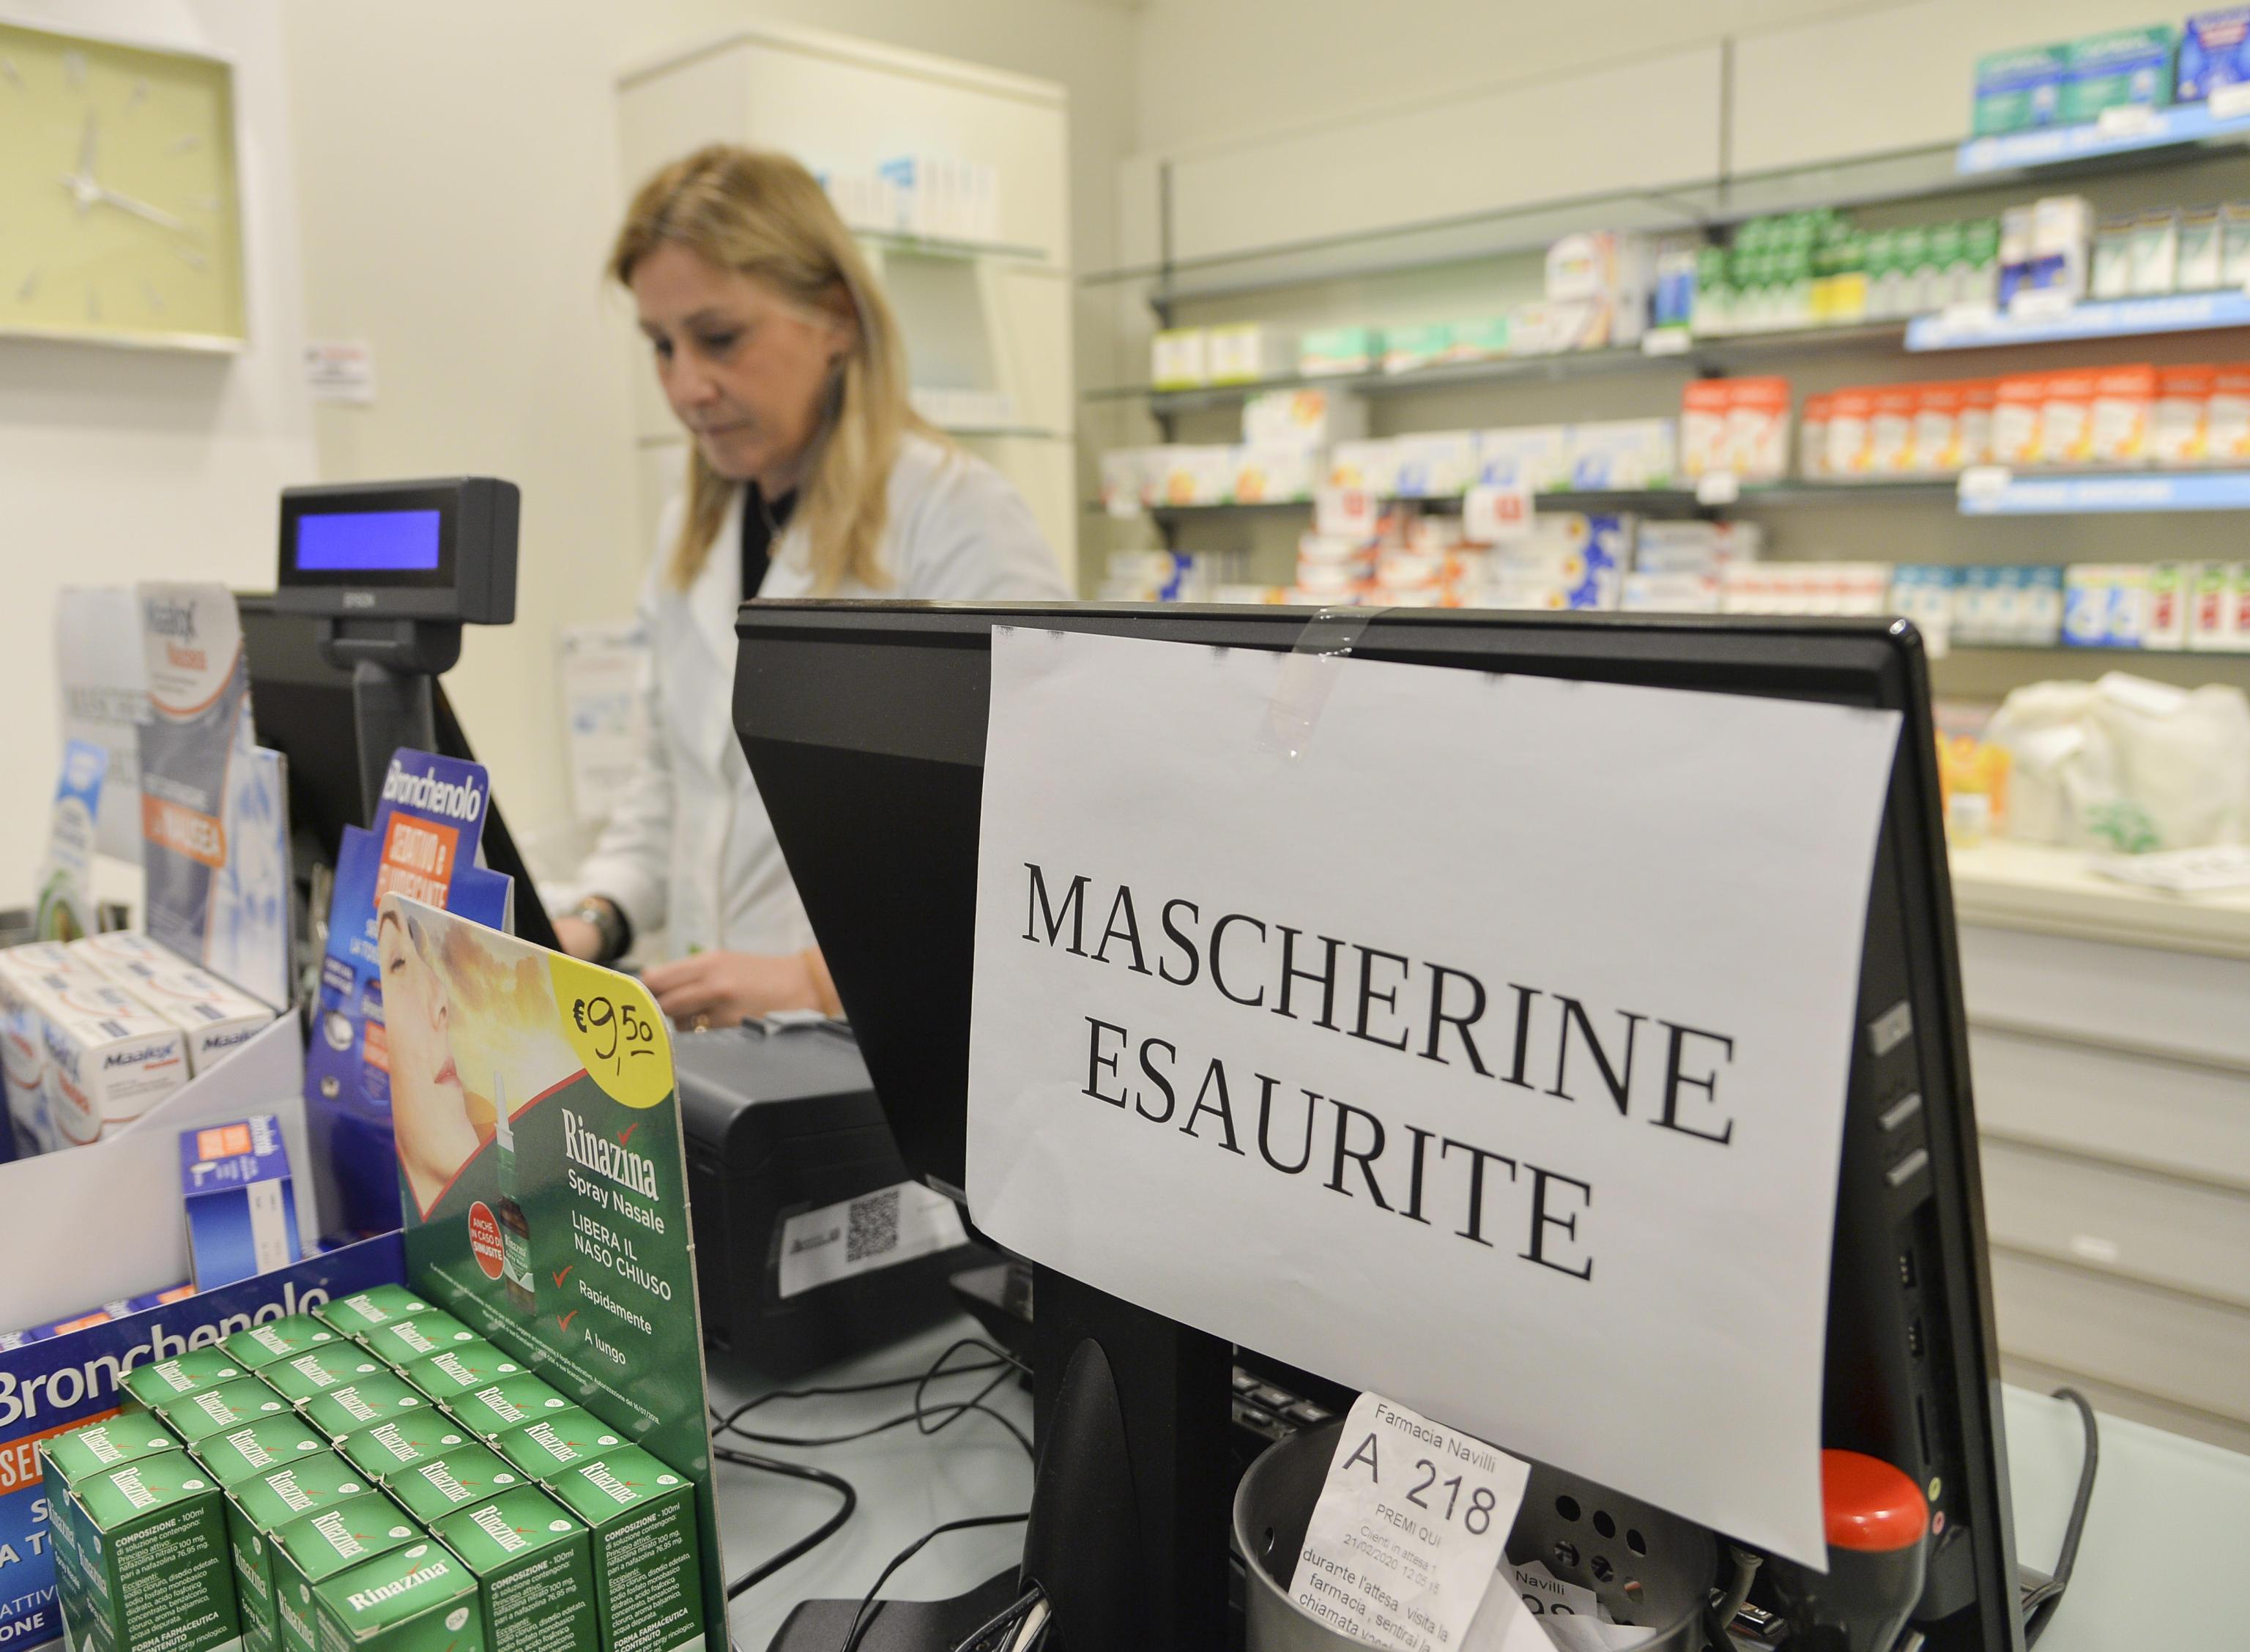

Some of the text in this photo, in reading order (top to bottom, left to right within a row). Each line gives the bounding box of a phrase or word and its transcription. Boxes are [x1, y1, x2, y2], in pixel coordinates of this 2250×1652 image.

[382, 759, 481, 822] Bronchenolo
[1022, 863, 1734, 1145] MASCHERINE
[562, 1109, 658, 1201] Rinazina
[1081, 1016, 1593, 1281] ESAURITE
[568, 1168, 664, 1234] Spray Nasale
[473, 1218, 493, 1232] ANCHE
[478, 1231, 494, 1244] CASO
[572, 1210, 637, 1261] LIBERA IL
[473, 1241, 502, 1260] SINUSITE
[575, 1232, 671, 1301] NASO CHIUSO
[344, 1295, 387, 1323] Rinazina
[579, 1279, 652, 1335] Rapidamente
[248, 1325, 292, 1355] Rinazina
[390, 1321, 435, 1353] Rinazina
[585, 1328, 625, 1365] A lungo
[152, 1360, 196, 1392] Rinazina
[290, 1355, 336, 1387] Rinazina
[431, 1352, 478, 1387] Rinazina
[193, 1391, 237, 1426] Rinazina
[330, 1386, 378, 1421] Rinazina
[475, 1385, 524, 1424] Rinazina
[78, 1426, 123, 1464] Rinazina
[226, 1429, 273, 1468] Rinazina
[369, 1423, 419, 1462] Rinazina
[524, 1422, 577, 1463] Rinazina
[1375, 1403, 1496, 1473] Farmacia Navilli
[109, 1467, 157, 1508] Rinazina
[264, 1469, 313, 1511] Rinazina
[418, 1460, 471, 1503] Rinazina
[579, 1462, 637, 1505] Rinazina
[1342, 1432, 1496, 1535] A 218
[116, 1507, 204, 1547] COMPOSIZIONE 100ml
[117, 1519, 200, 1556] di soluzione contengono:
[311, 1511, 364, 1559] Rinazina
[469, 1505, 527, 1552] Rinazina
[605, 1503, 680, 1542] COMPOSIZIONE 100ml
[614, 1514, 677, 1547] soluzione contengono:
[1375, 1504, 1441, 1548] PREMI QUI
[118, 1539, 171, 1565] Principio attivo:
[119, 1555, 154, 1572] nafazolina
[156, 1545, 178, 1560] nitrato
[179, 1539, 191, 1548] 100
[121, 1570, 134, 1582] pari
[141, 1555, 176, 1572] nafazolina
[177, 1547, 196, 1558] 76,95
[606, 1534, 651, 1559] Principio attivo:
[607, 1533, 668, 1567] nafazolina nitrato 100
[625, 1541, 671, 1568] nafazolina 76,95
[1343, 1534, 1398, 1570] 21/02/2020
[1361, 1526, 1389, 1547] Clienti
[1392, 1541, 1400, 1554] in
[1402, 1548, 1428, 1570] attesa
[77, 1541, 108, 1599] Rinazina
[122, 1573, 157, 1592] Eccipienti:
[124, 1558, 218, 1600] sodio cloruro, disodio edetato,
[125, 1570, 207, 1608] sodio fosfato monobasico
[233, 1542, 267, 1601] Rinazina
[346, 1560, 450, 1611] Rinazina
[491, 1549, 573, 1591] COMPOSIZIONE 100ml
[1516, 1571, 1564, 1595] Navilli
[127, 1582, 201, 1616] diidrato, acido fosforico
[127, 1587, 207, 1625] concentrato, benzalconio
[129, 1595, 209, 1633] cloruro, aroma balsamico,
[1299, 1593, 1358, 1635] chiamata
[1303, 1549, 1448, 1642] durante l'attesa visita la
[1310, 1573, 1365, 1615] farmacia
[1375, 1614, 1419, 1651] sentirai
[130, 1616, 182, 1642] acqua depurata.
[132, 1611, 219, 1652] FORMA FARMACEUTICA
[179, 1627, 228, 1651] spray rinologico.
[278, 1588, 316, 1652] Rinazina
[614, 1607, 688, 1649] FORMA FARMACEUTICA
[668, 1621, 695, 1638] rinologico.
